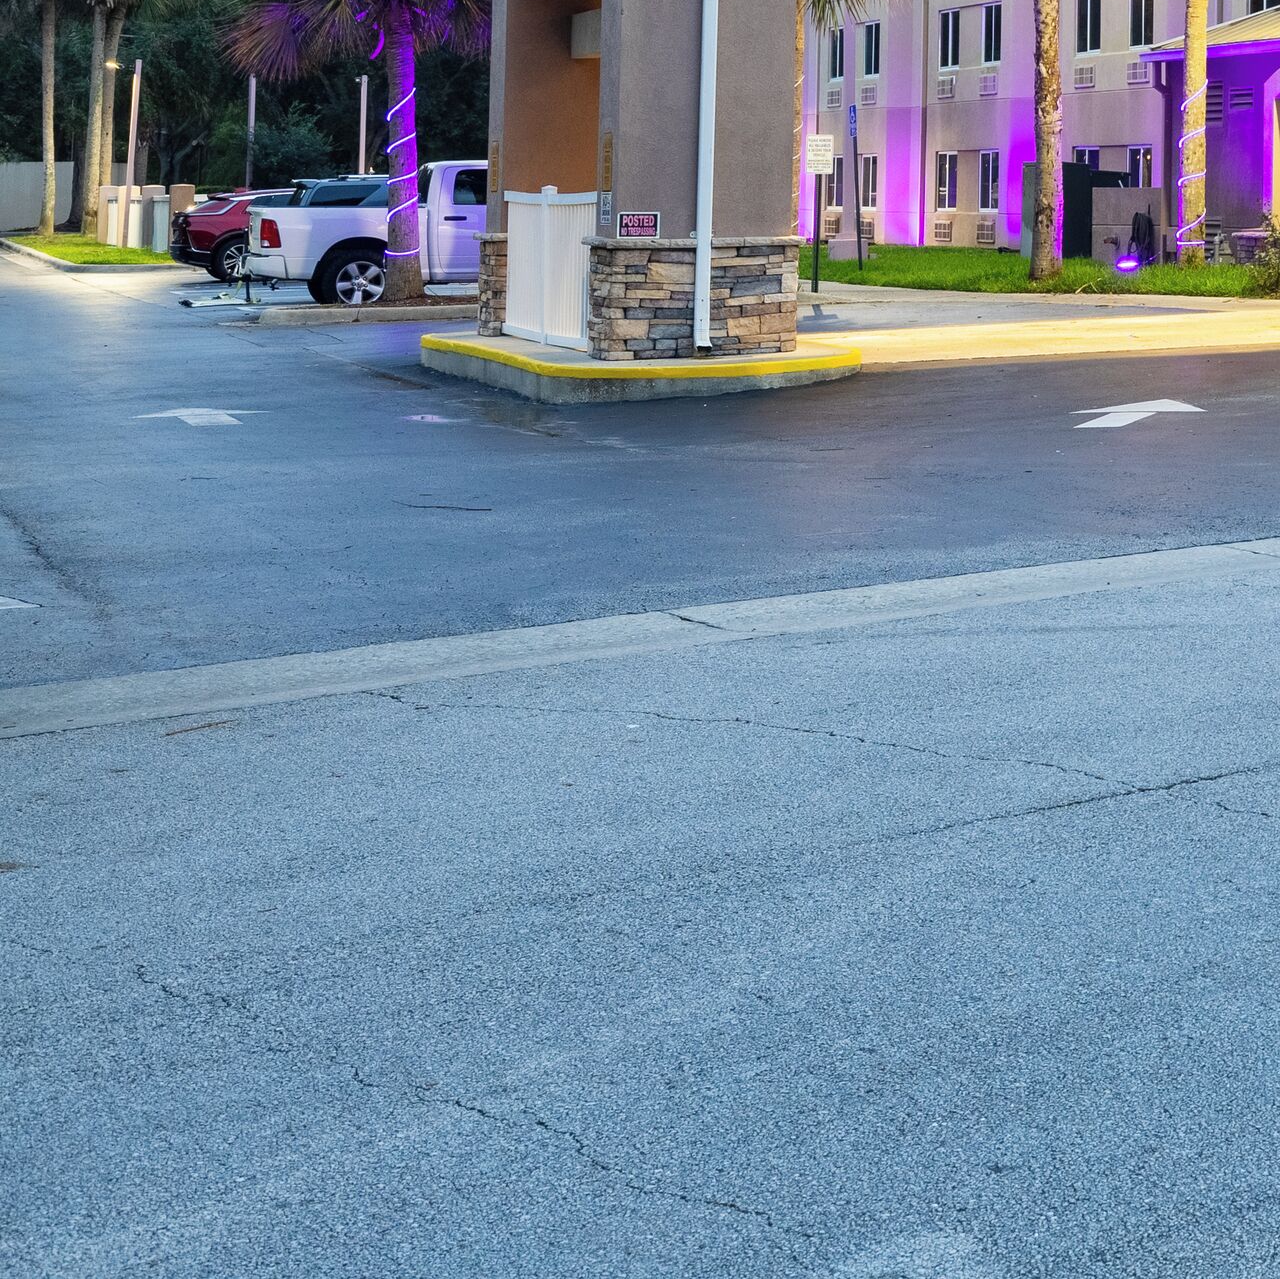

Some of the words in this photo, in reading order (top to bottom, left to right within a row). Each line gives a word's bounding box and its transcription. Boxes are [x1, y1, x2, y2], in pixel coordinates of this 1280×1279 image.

[622, 215, 655, 227] POSTED
[621, 227, 628, 236] NO
[628, 227, 656, 236] TRESPASSING
